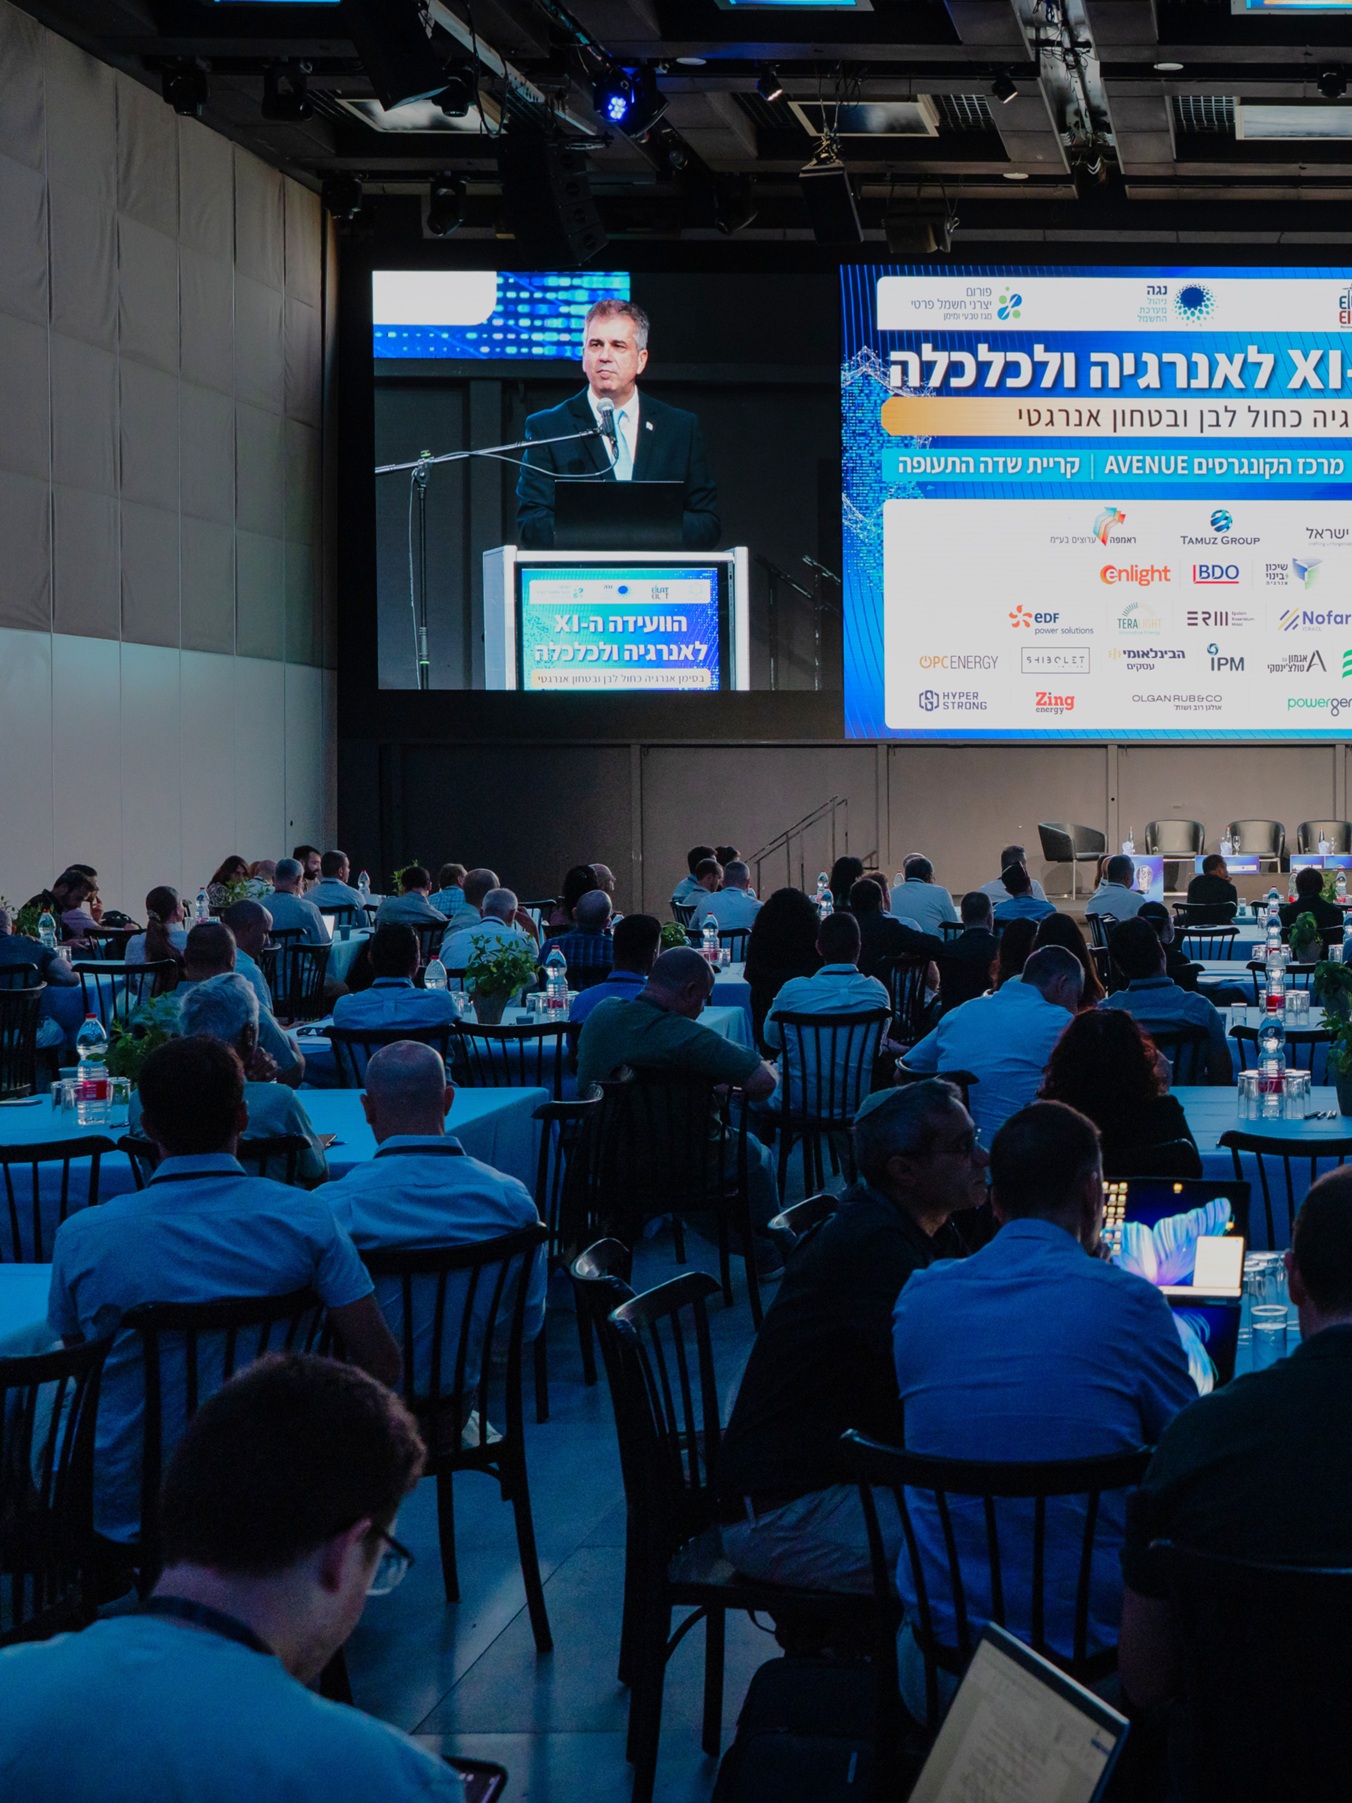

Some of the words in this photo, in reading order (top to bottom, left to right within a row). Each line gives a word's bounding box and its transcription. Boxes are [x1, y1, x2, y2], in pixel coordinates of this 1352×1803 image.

[966, 287, 992, 297] פורום
[1146, 285, 1168, 295] נגה
[911, 300, 935, 310] פרטי
[937, 298, 967, 310] חשמל
[969, 300, 992, 310] יצרני
[1139, 306, 1168, 314] מערכת
[1137, 314, 1168, 323] החשמל
[889, 343, 1077, 390] ולכלכלה
[1089, 345, 1275, 391] לאנרגיה
[1017, 407, 1101, 428] אנרגטי
[1111, 407, 1188, 434] ובטחון
[1199, 405, 1238, 433] לבן
[1247, 405, 1302, 428] כחול
[898, 456, 974, 475] התעופה
[979, 456, 1023, 474] שדה
[1026, 456, 1080, 480] קריית
[1104, 455, 1189, 475] AVENUE
[1194, 456, 1292, 480] הקונגרסים
[1297, 457, 1345, 475] מרכז
[1306, 527, 1349, 540] ישראל
[1071, 536, 1097, 544] ערוצים
[1109, 536, 1137, 544] ראמפה
[1180, 535, 1218, 545] TAMUZ
[1220, 535, 1261, 545] GROUP
[1198, 564, 1240, 580] BDO
[1265, 562, 1289, 572] שיכון
[1100, 564, 1171, 587] enlight
[608, 614, 687, 633] הוועידה
[1302, 610, 1352, 626] Nofar
[1034, 627, 1059, 636] power
[1060, 626, 1094, 635] solutions
[534, 641, 619, 661] ולכלכלה
[623, 641, 708, 661] לאנרגיה
[1122, 648, 1186, 659] הבינלאומי
[1210, 656, 1245, 672] IPM
[1288, 654, 1308, 664] אגמון
[1126, 662, 1155, 672] עסקים
[537, 675, 570, 684] אנרגטי
[572, 675, 601, 685] ובטחון
[603, 674, 618, 685] לבן
[620, 673, 642, 683] כחול
[644, 675, 676, 683] אנרגיה
[678, 674, 705, 685] בסימן
[942, 691, 979, 700] HYPER
[1035, 691, 1075, 711] Zing
[942, 701, 988, 710] STRONG
[1035, 706, 1065, 715] energy
